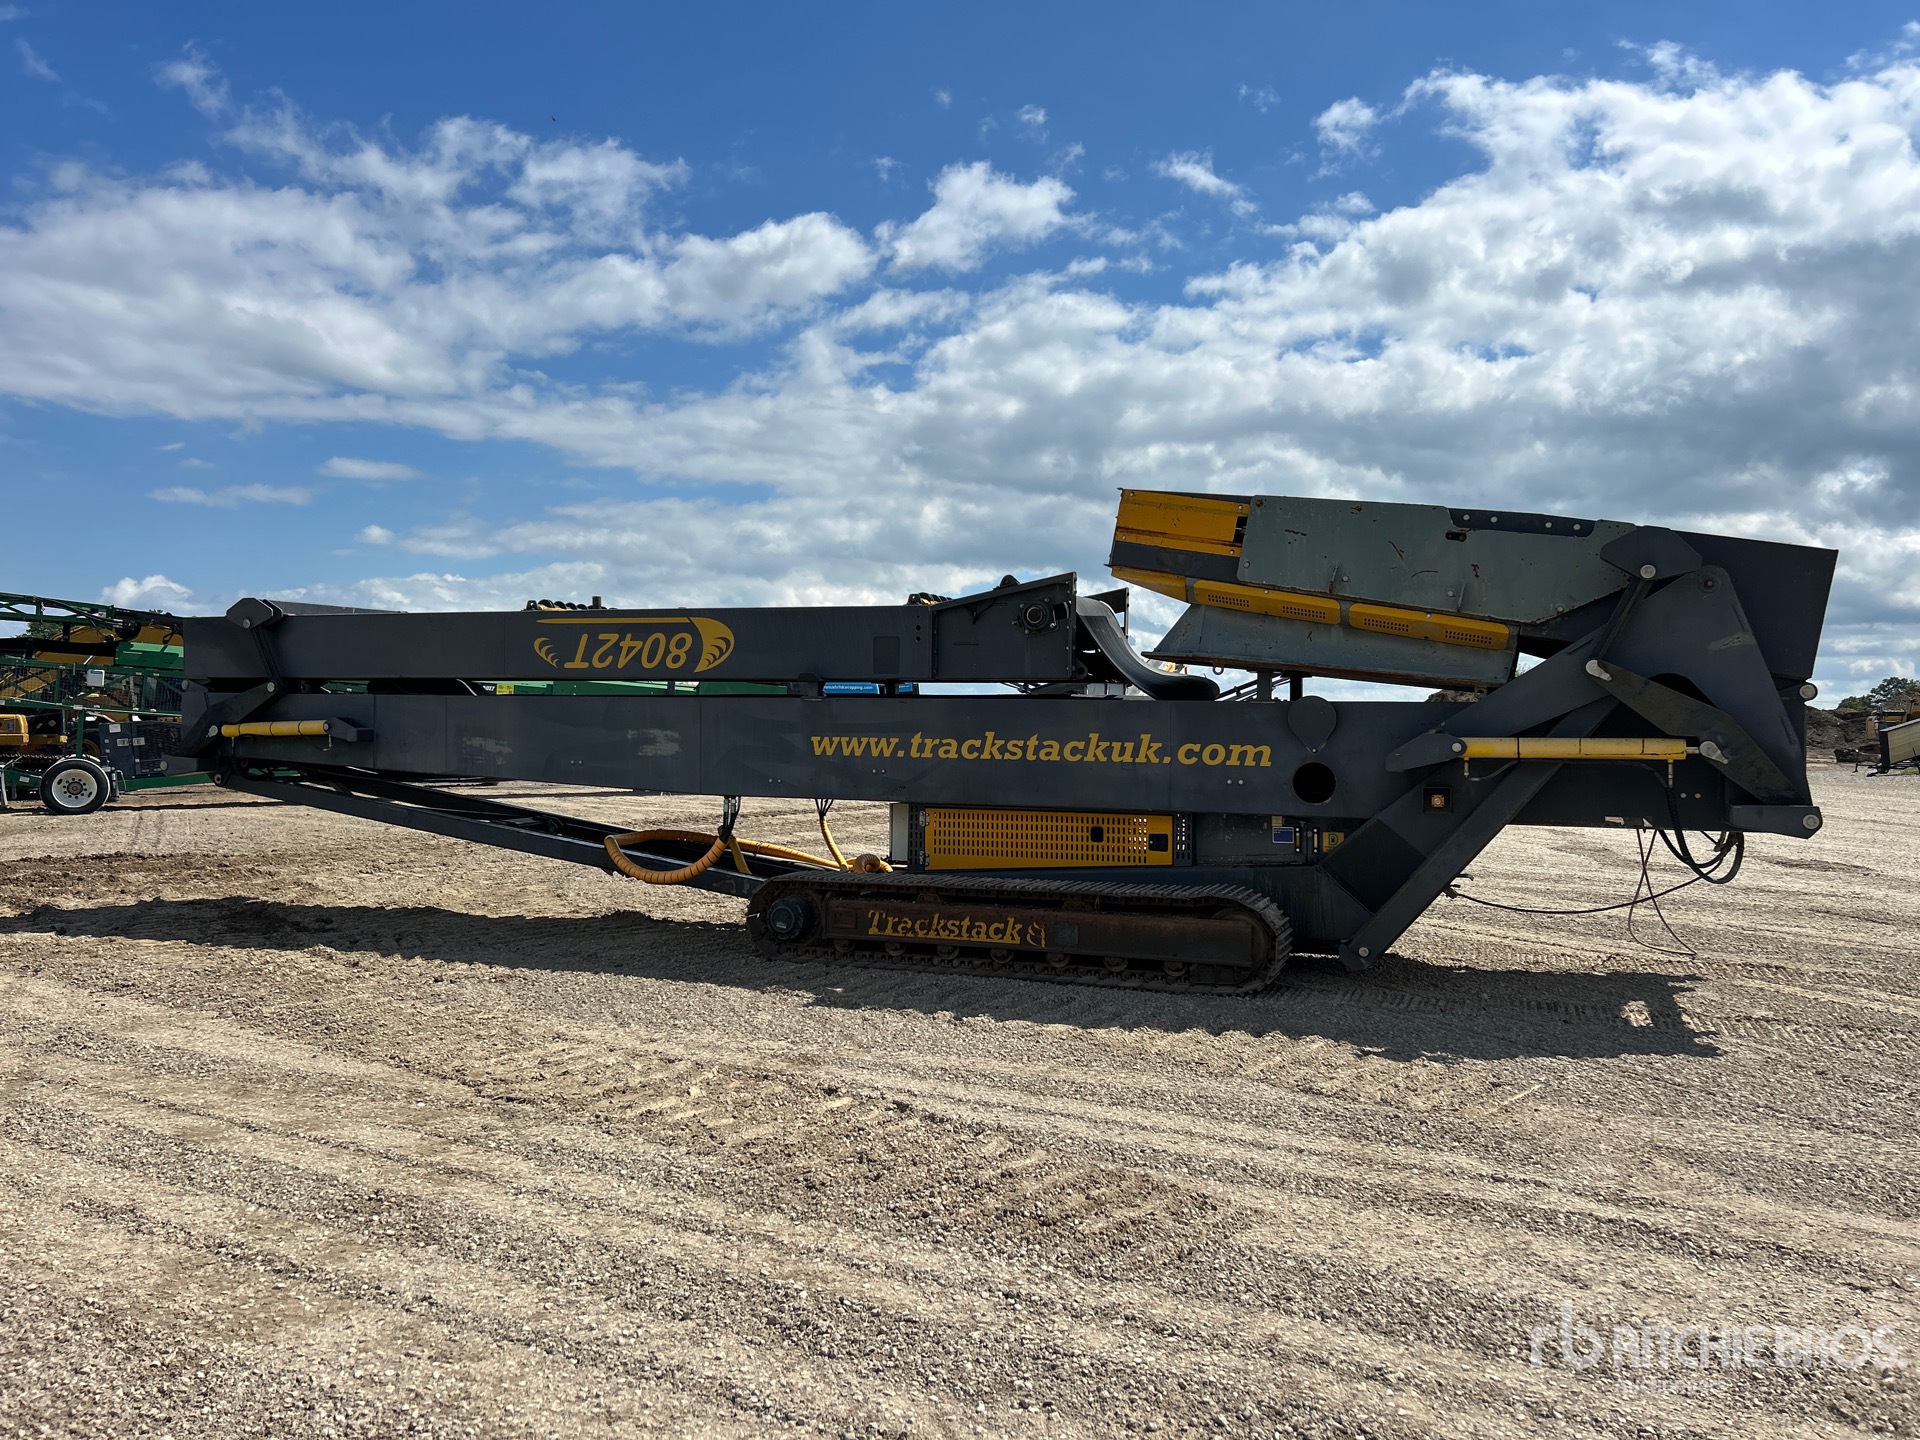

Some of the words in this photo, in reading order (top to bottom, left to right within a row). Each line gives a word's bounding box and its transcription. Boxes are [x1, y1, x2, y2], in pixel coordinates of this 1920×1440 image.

[563, 632, 693, 669] 8042T
[810, 731, 1272, 768] www.trackstackuk.com
[867, 909, 1022, 944] Trackstack
